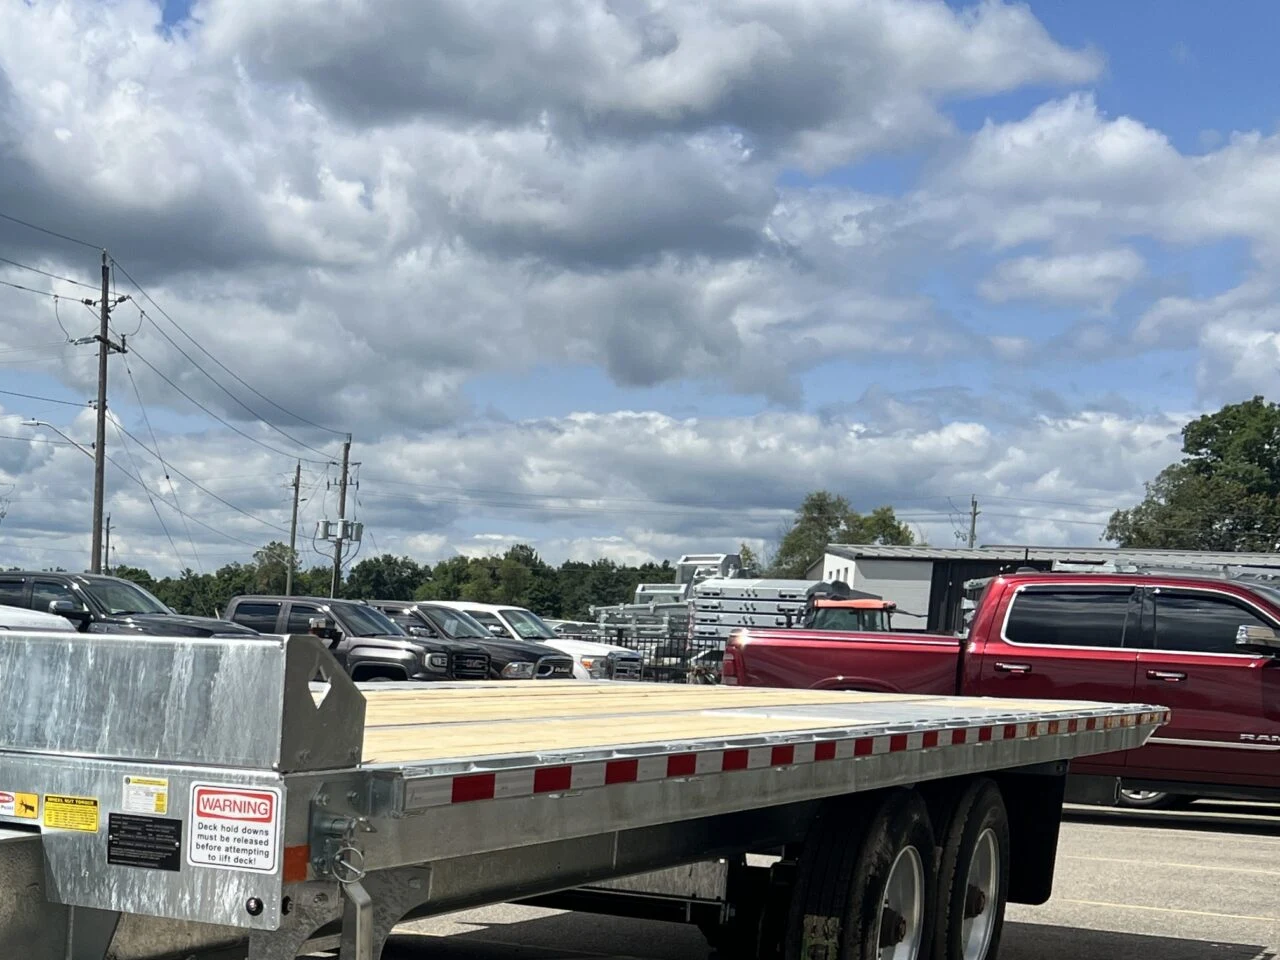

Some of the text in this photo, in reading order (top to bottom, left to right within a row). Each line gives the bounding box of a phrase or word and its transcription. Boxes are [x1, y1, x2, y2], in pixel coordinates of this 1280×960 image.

[202, 797, 268, 816] WARNING
[197, 822, 269, 836] Deck hold downs
[197, 833, 217, 841] must
[233, 836, 269, 846] released
[195, 842, 269, 858] before attempting
[219, 855, 231, 863] lift
[233, 856, 256, 865] deck!
